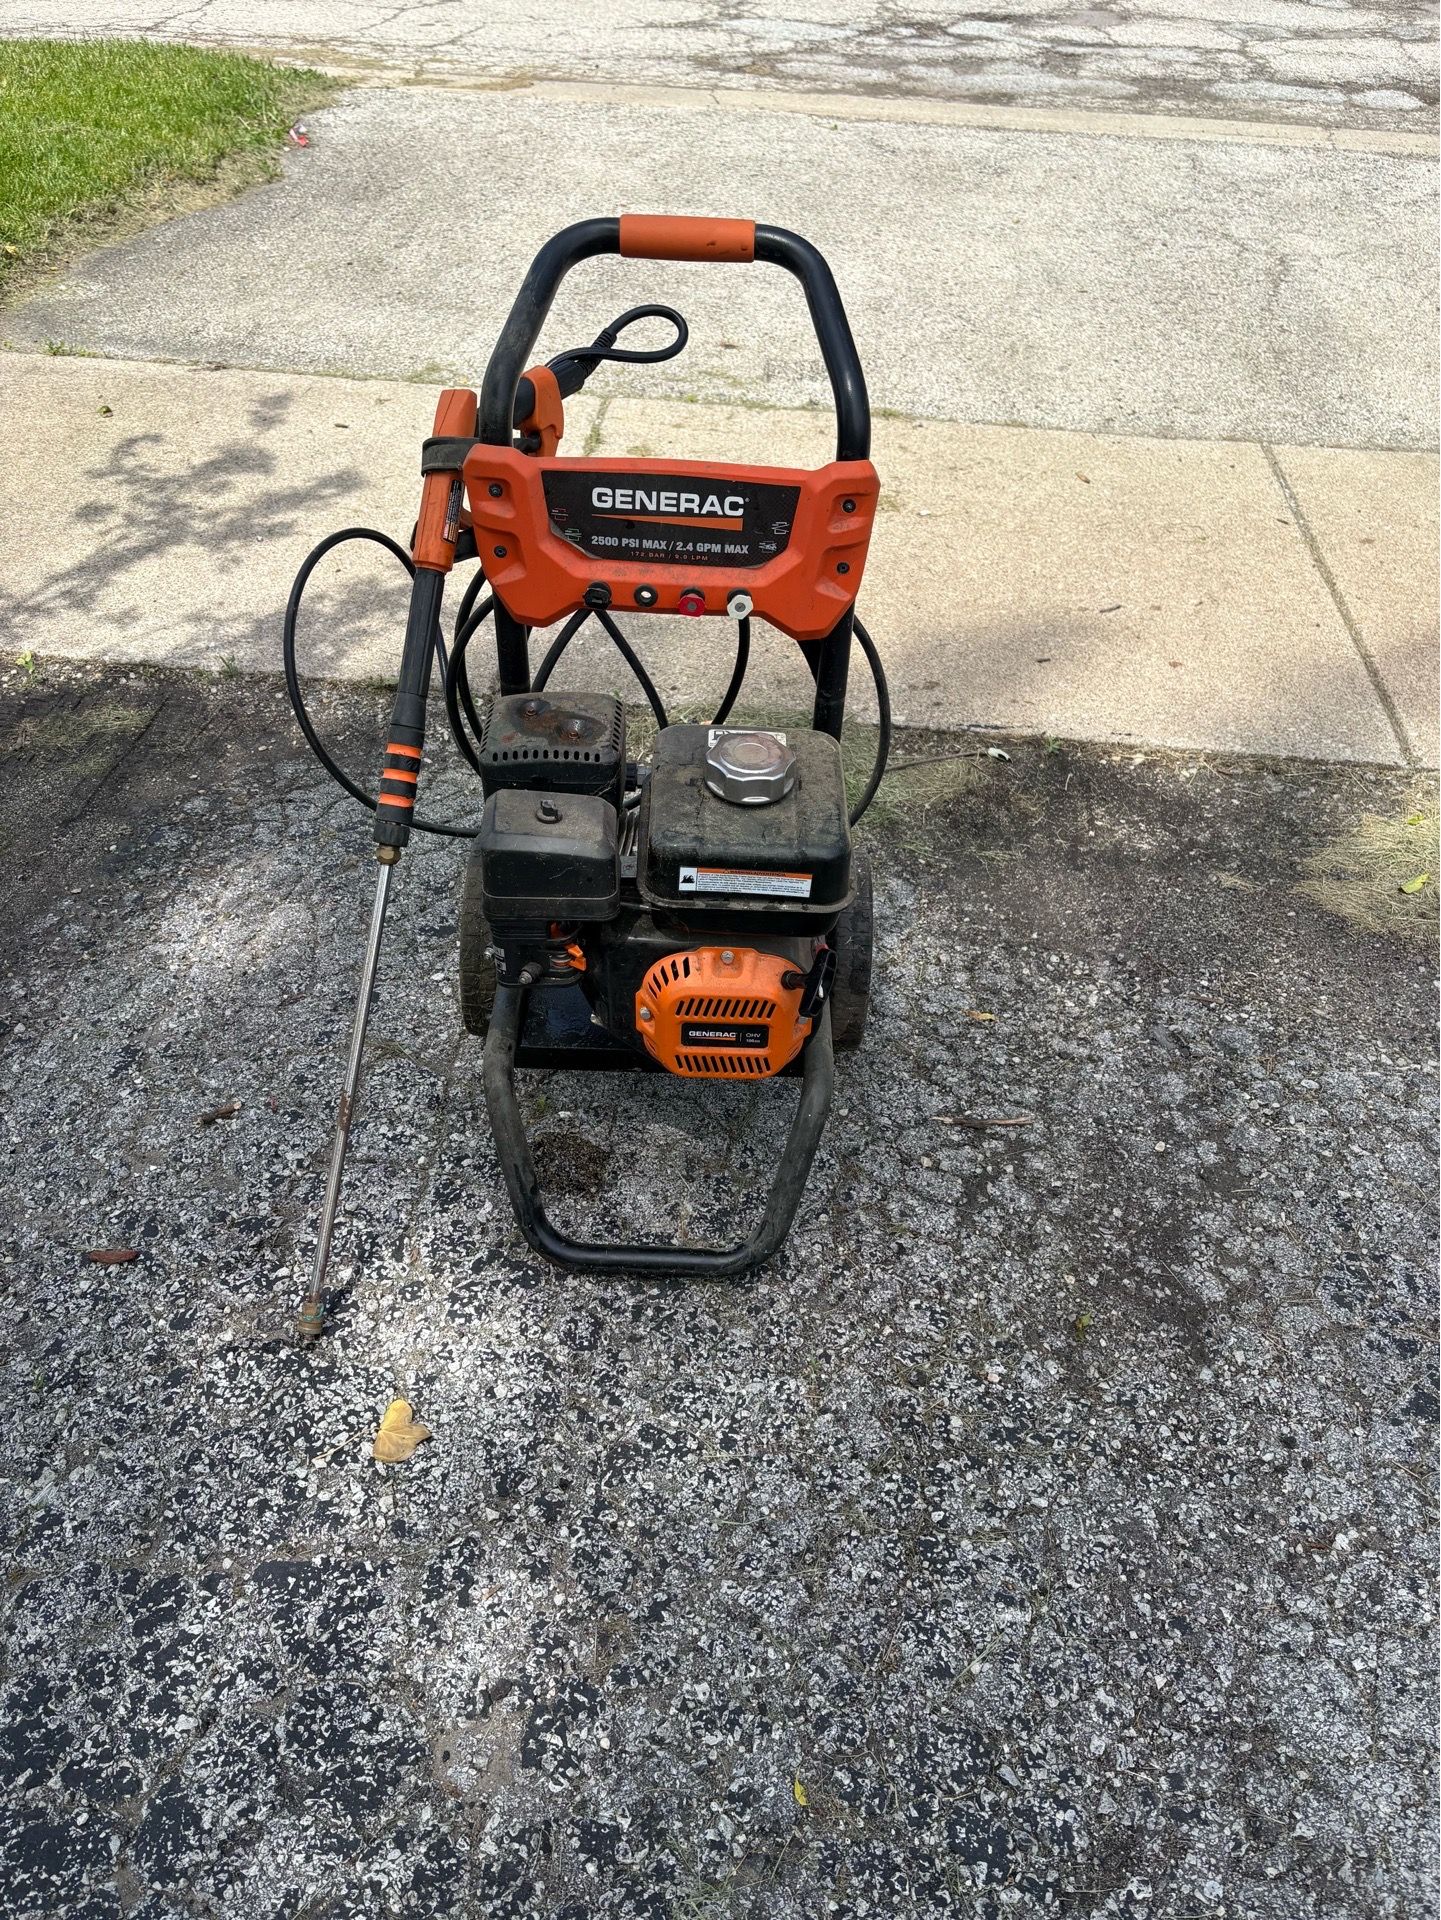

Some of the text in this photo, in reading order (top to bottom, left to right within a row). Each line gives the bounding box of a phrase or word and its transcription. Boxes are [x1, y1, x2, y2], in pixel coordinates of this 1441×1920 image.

[592, 487, 744, 516] GENERAC
[591, 536, 749, 554] 2500 PSI MAX / 2.4 GPM MAX
[688, 1030, 737, 1038] GENERAC
